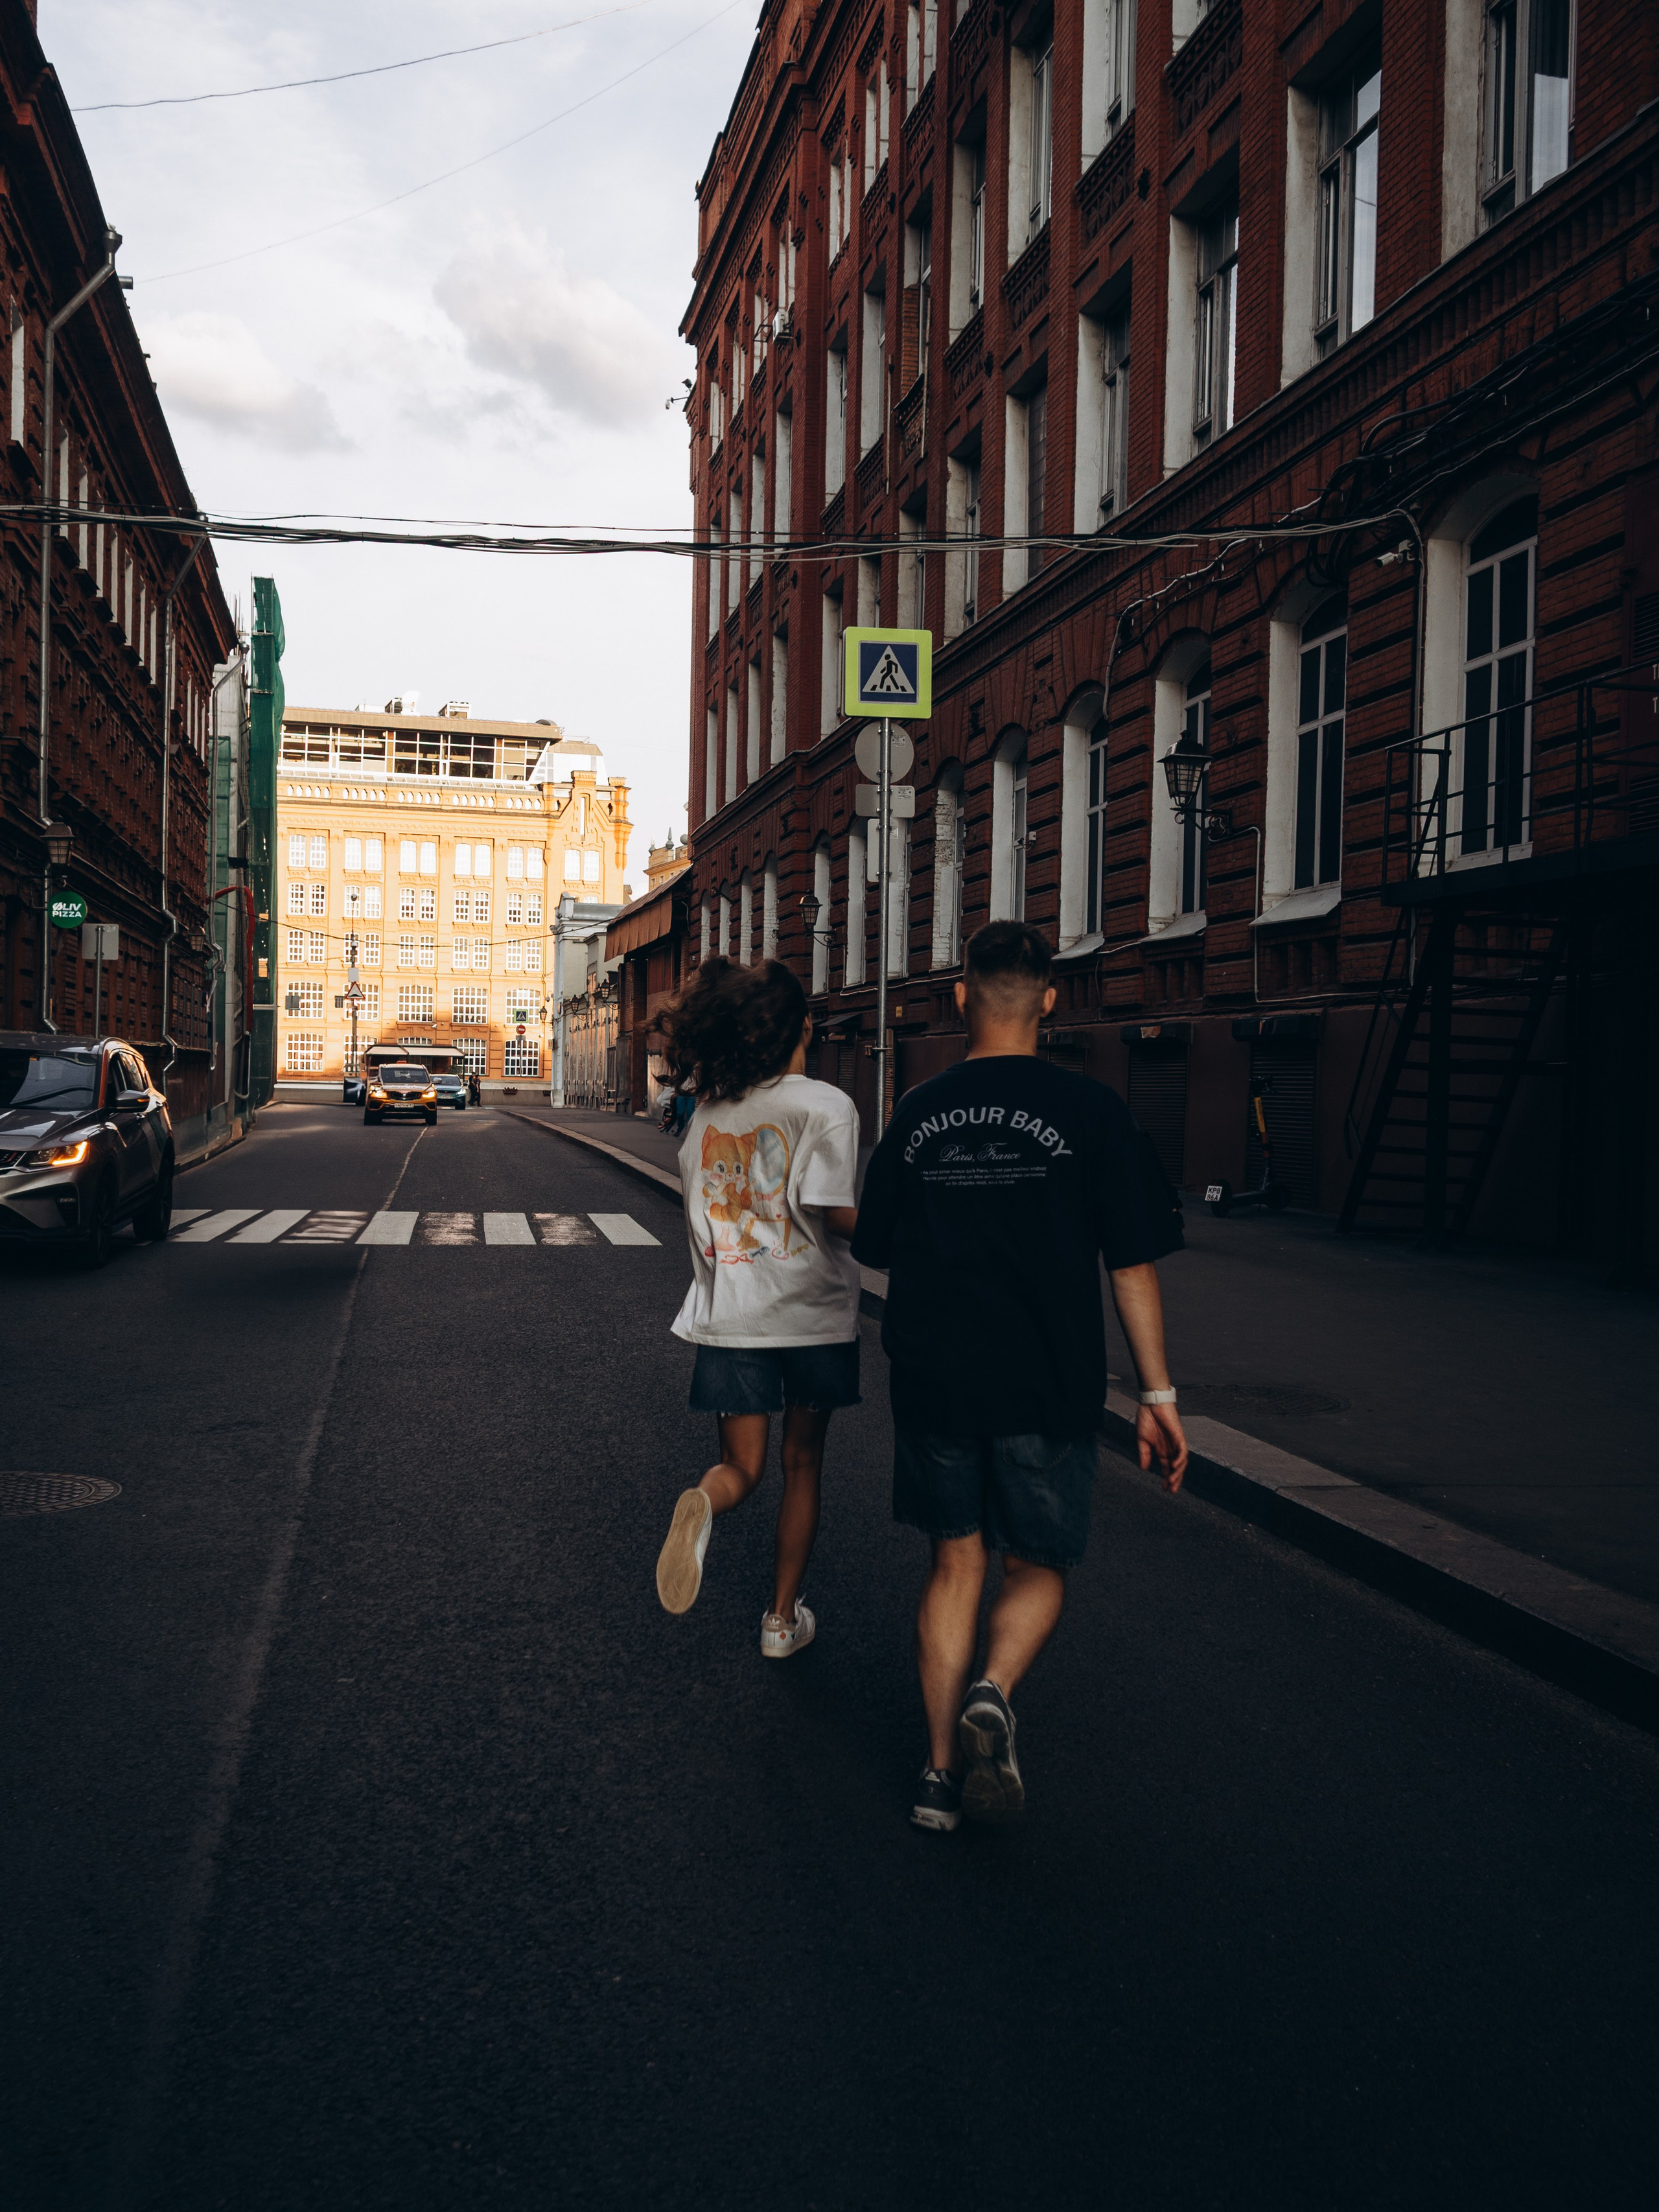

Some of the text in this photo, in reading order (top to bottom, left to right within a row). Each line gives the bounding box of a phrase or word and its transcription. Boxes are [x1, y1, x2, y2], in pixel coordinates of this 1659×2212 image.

[904, 1106, 1073, 1165] BONJOUR BABY
[938, 1142, 1022, 1162] Paris, France
